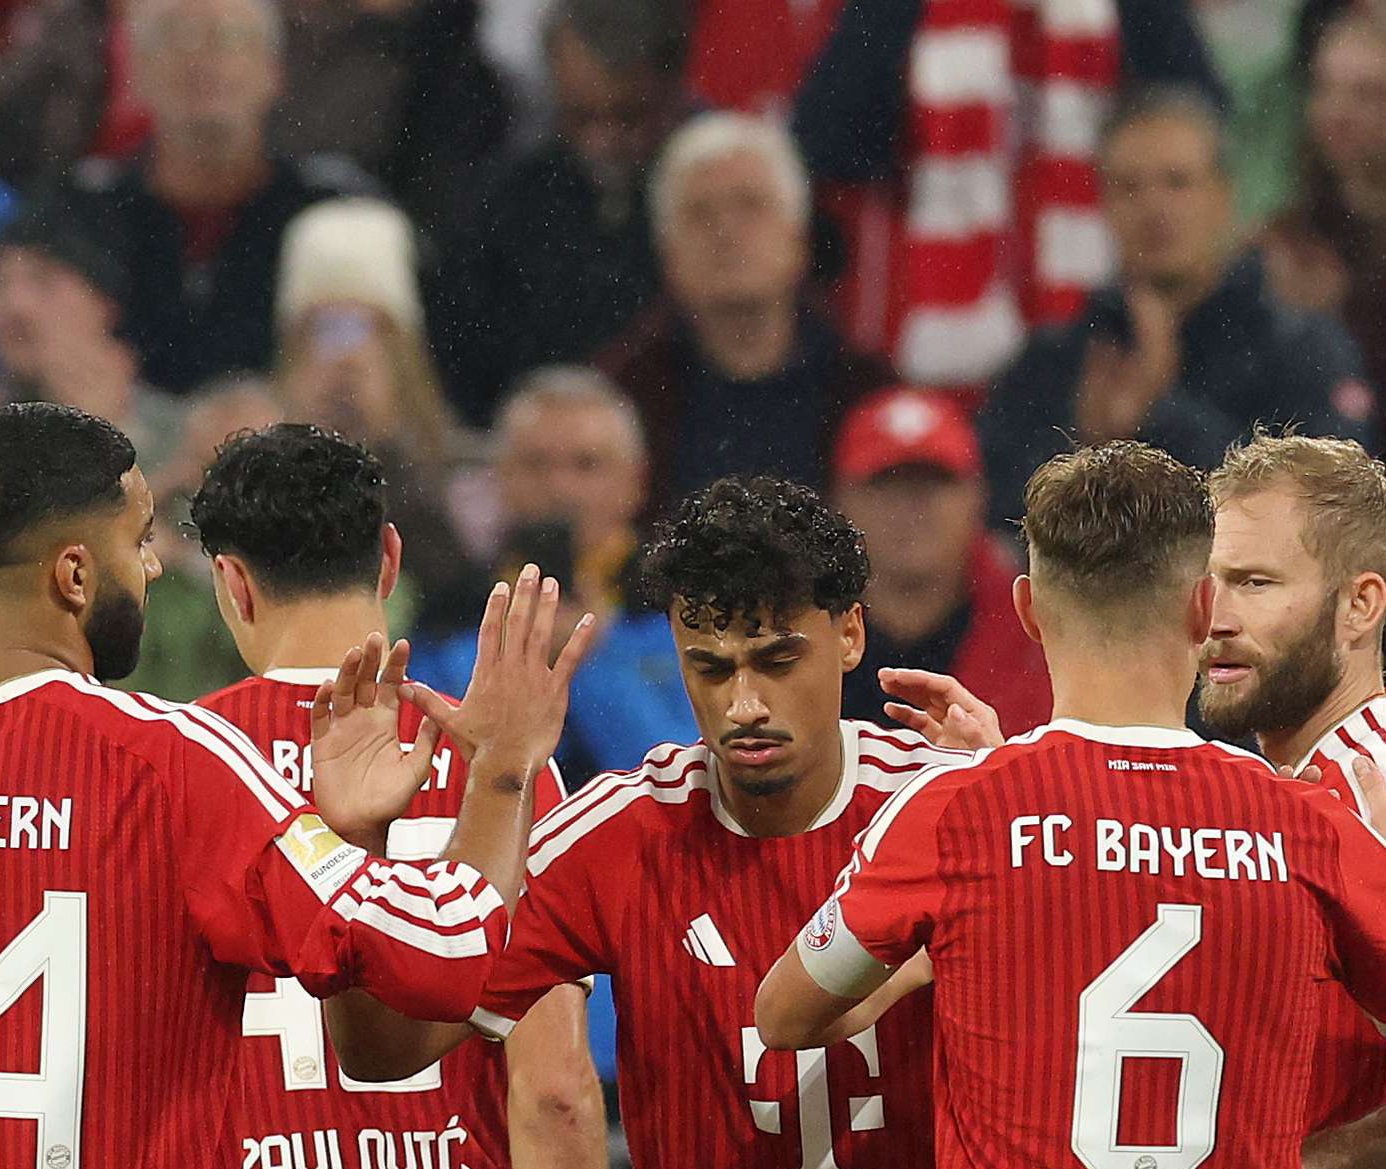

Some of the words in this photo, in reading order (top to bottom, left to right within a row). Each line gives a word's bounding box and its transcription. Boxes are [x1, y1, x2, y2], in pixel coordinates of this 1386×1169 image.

[1108, 759, 1130, 771] MIA
[1131, 762, 1154, 771] SAN
[1155, 763, 1178, 772] MIA
[1010, 814, 1074, 868] FC
[1096, 819, 1288, 882] BAYERN
